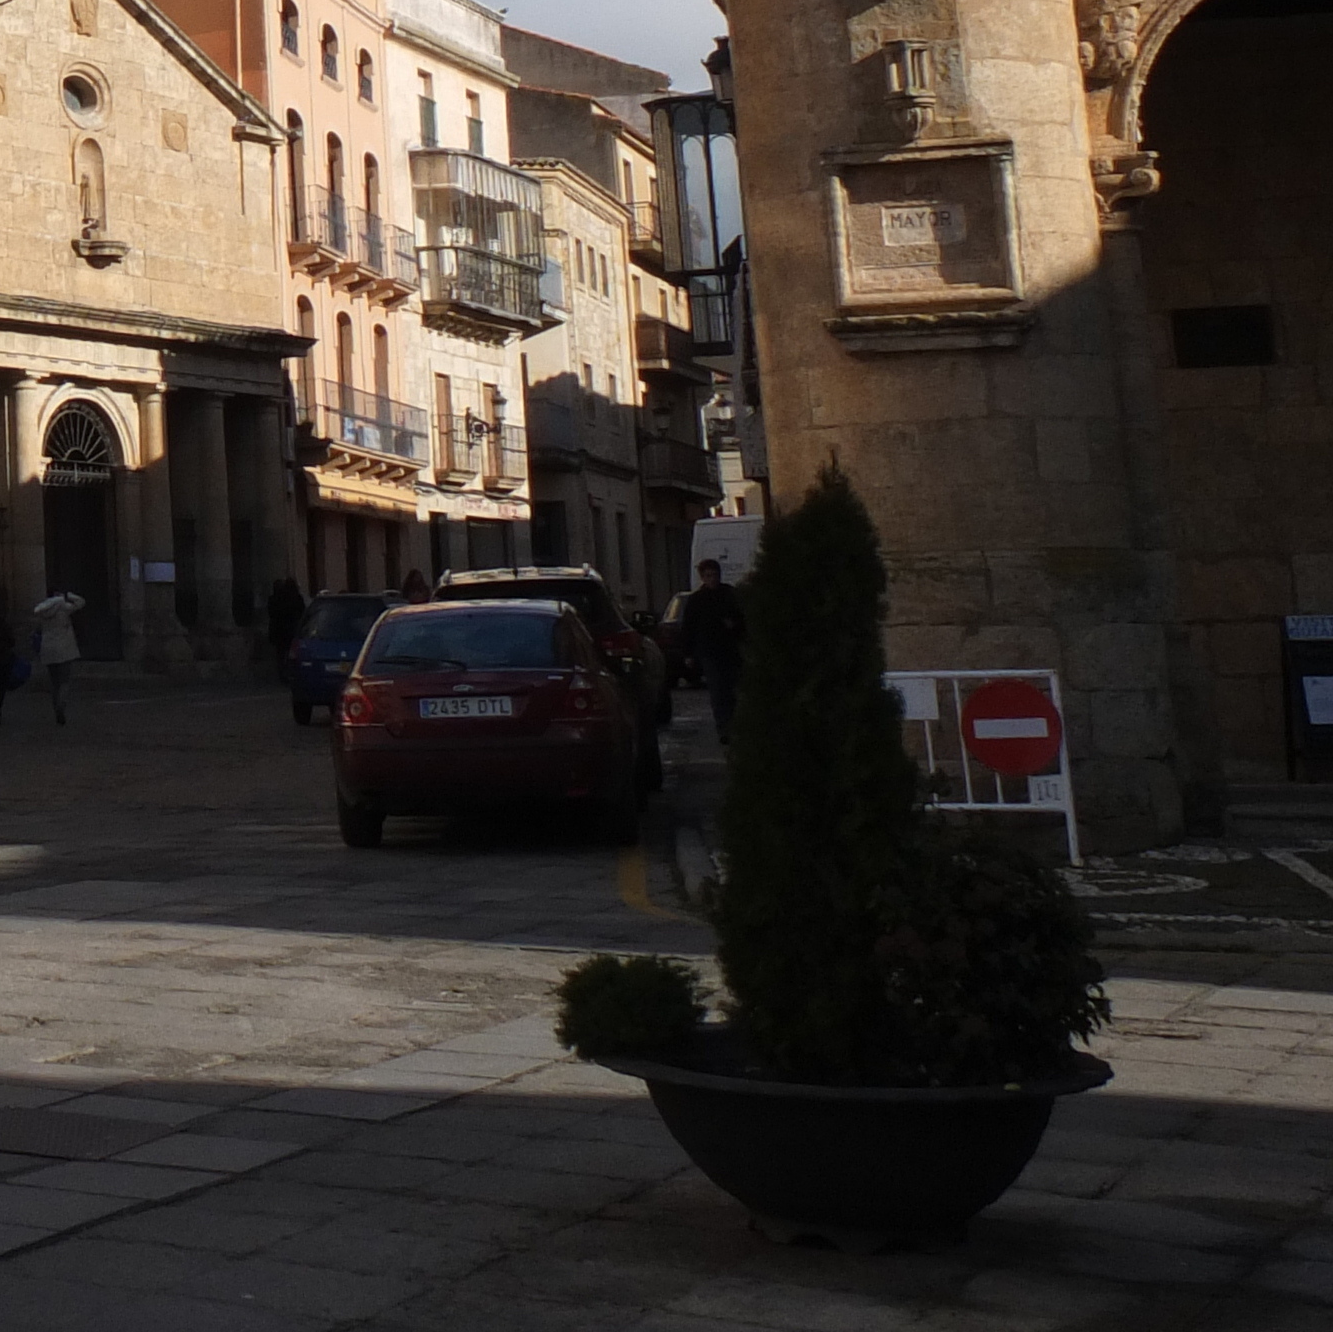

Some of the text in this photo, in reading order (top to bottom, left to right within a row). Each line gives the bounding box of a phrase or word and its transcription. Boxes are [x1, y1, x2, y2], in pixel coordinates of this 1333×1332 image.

[889, 211, 952, 230] MAYOR
[428, 698, 510, 716] 2435 DTL
